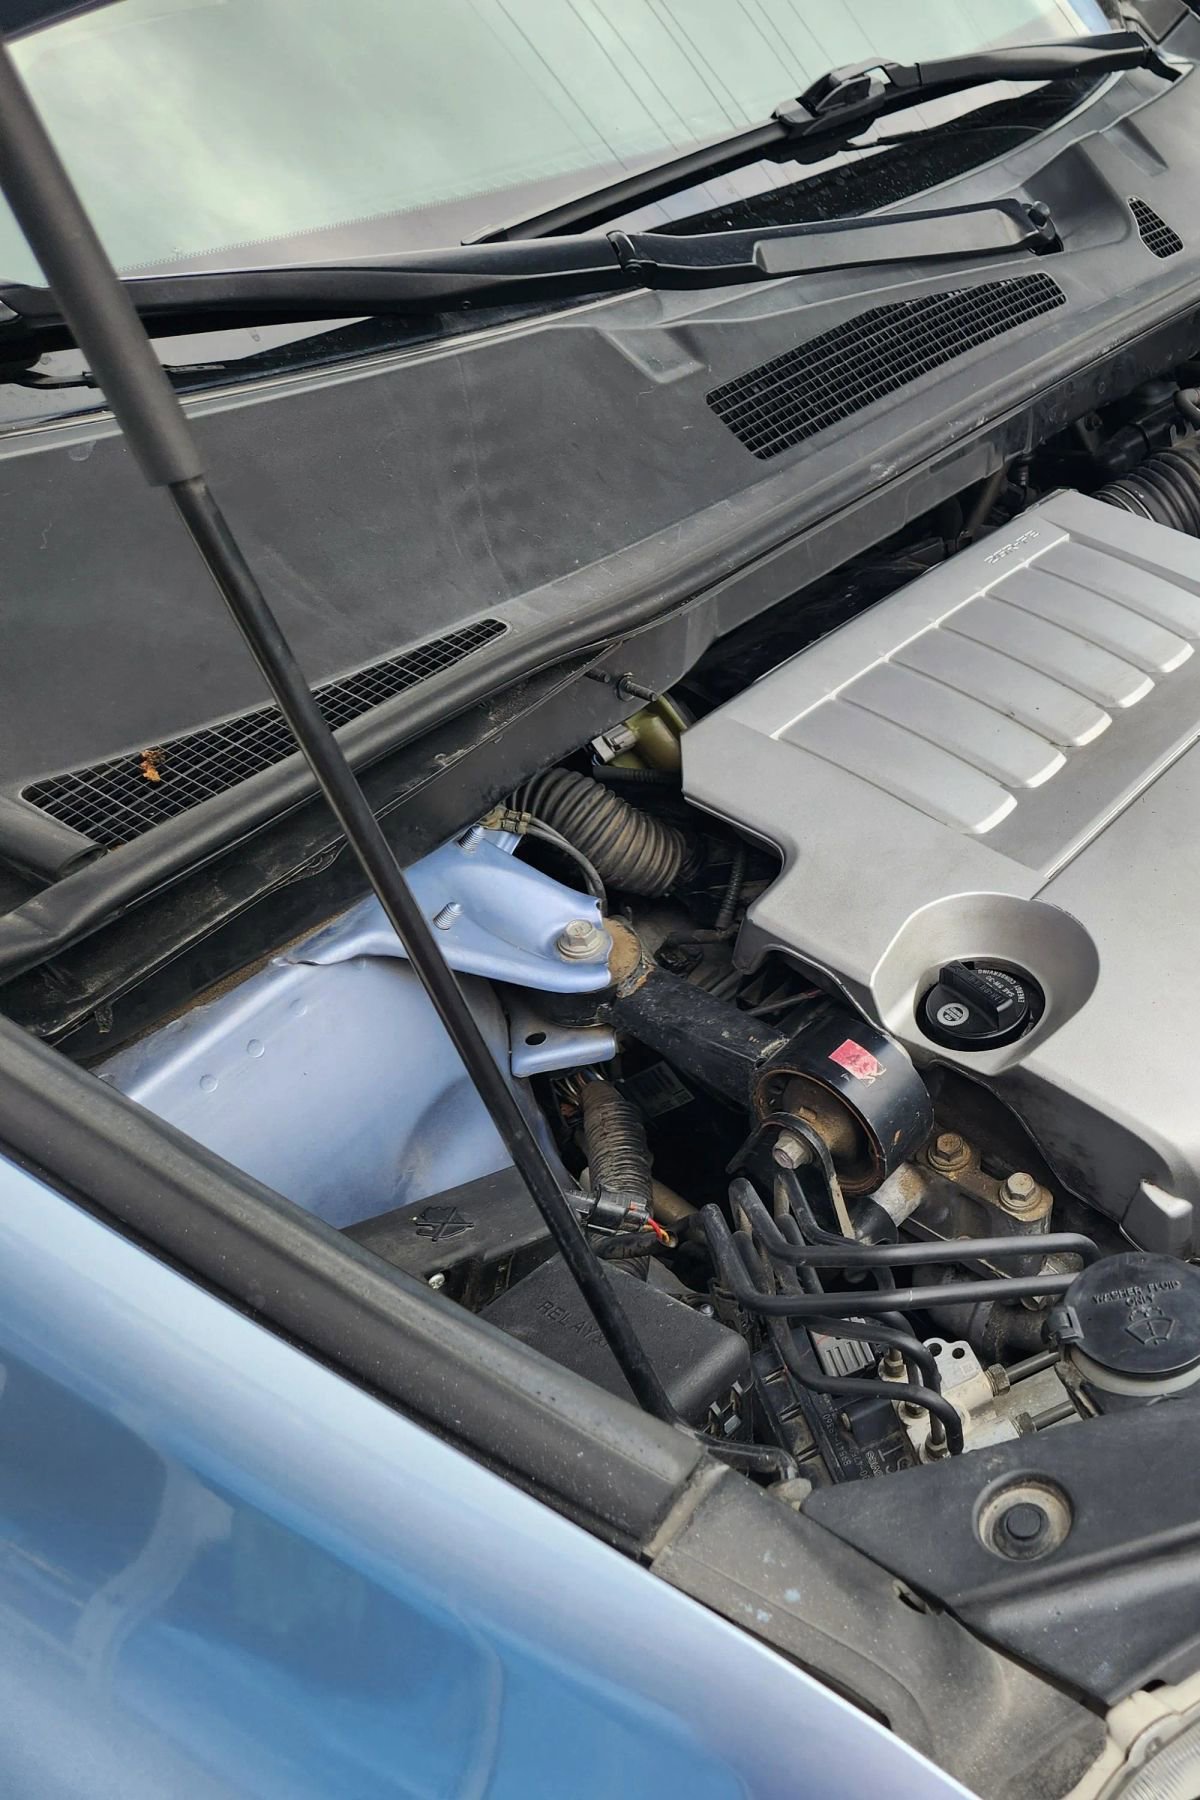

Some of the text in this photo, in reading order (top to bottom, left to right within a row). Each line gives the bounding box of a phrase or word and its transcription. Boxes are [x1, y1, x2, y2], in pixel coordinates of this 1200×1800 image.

[1092, 1280, 1181, 1305] WASHER FLUID
[1125, 1293, 1155, 1308] ONLY
